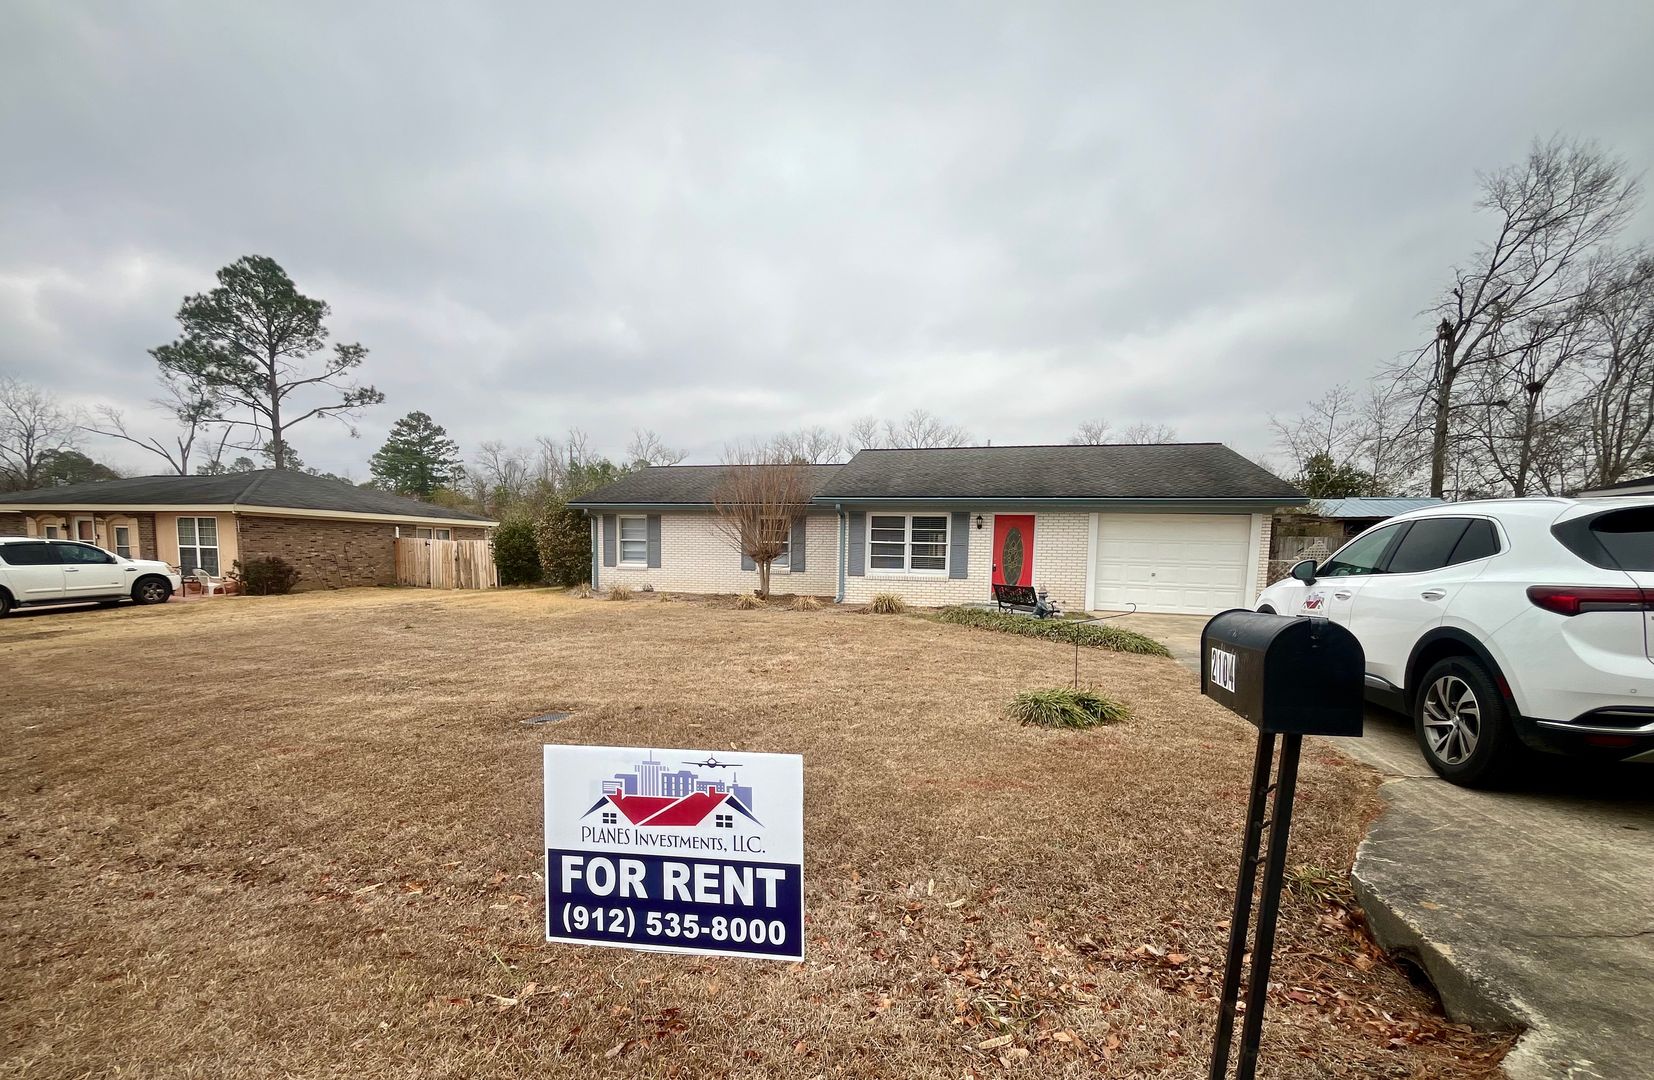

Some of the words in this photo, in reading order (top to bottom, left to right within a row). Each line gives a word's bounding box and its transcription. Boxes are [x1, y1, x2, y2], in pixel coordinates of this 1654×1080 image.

[1212, 649, 1234, 691] 2104
[581, 825, 630, 845] PLANES
[732, 834, 766, 854] LLC.
[561, 855, 648, 899] FOR
[663, 861, 786, 908] RENT
[562, 902, 636, 938] (912)
[646, 911, 786, 946] 535-8000
